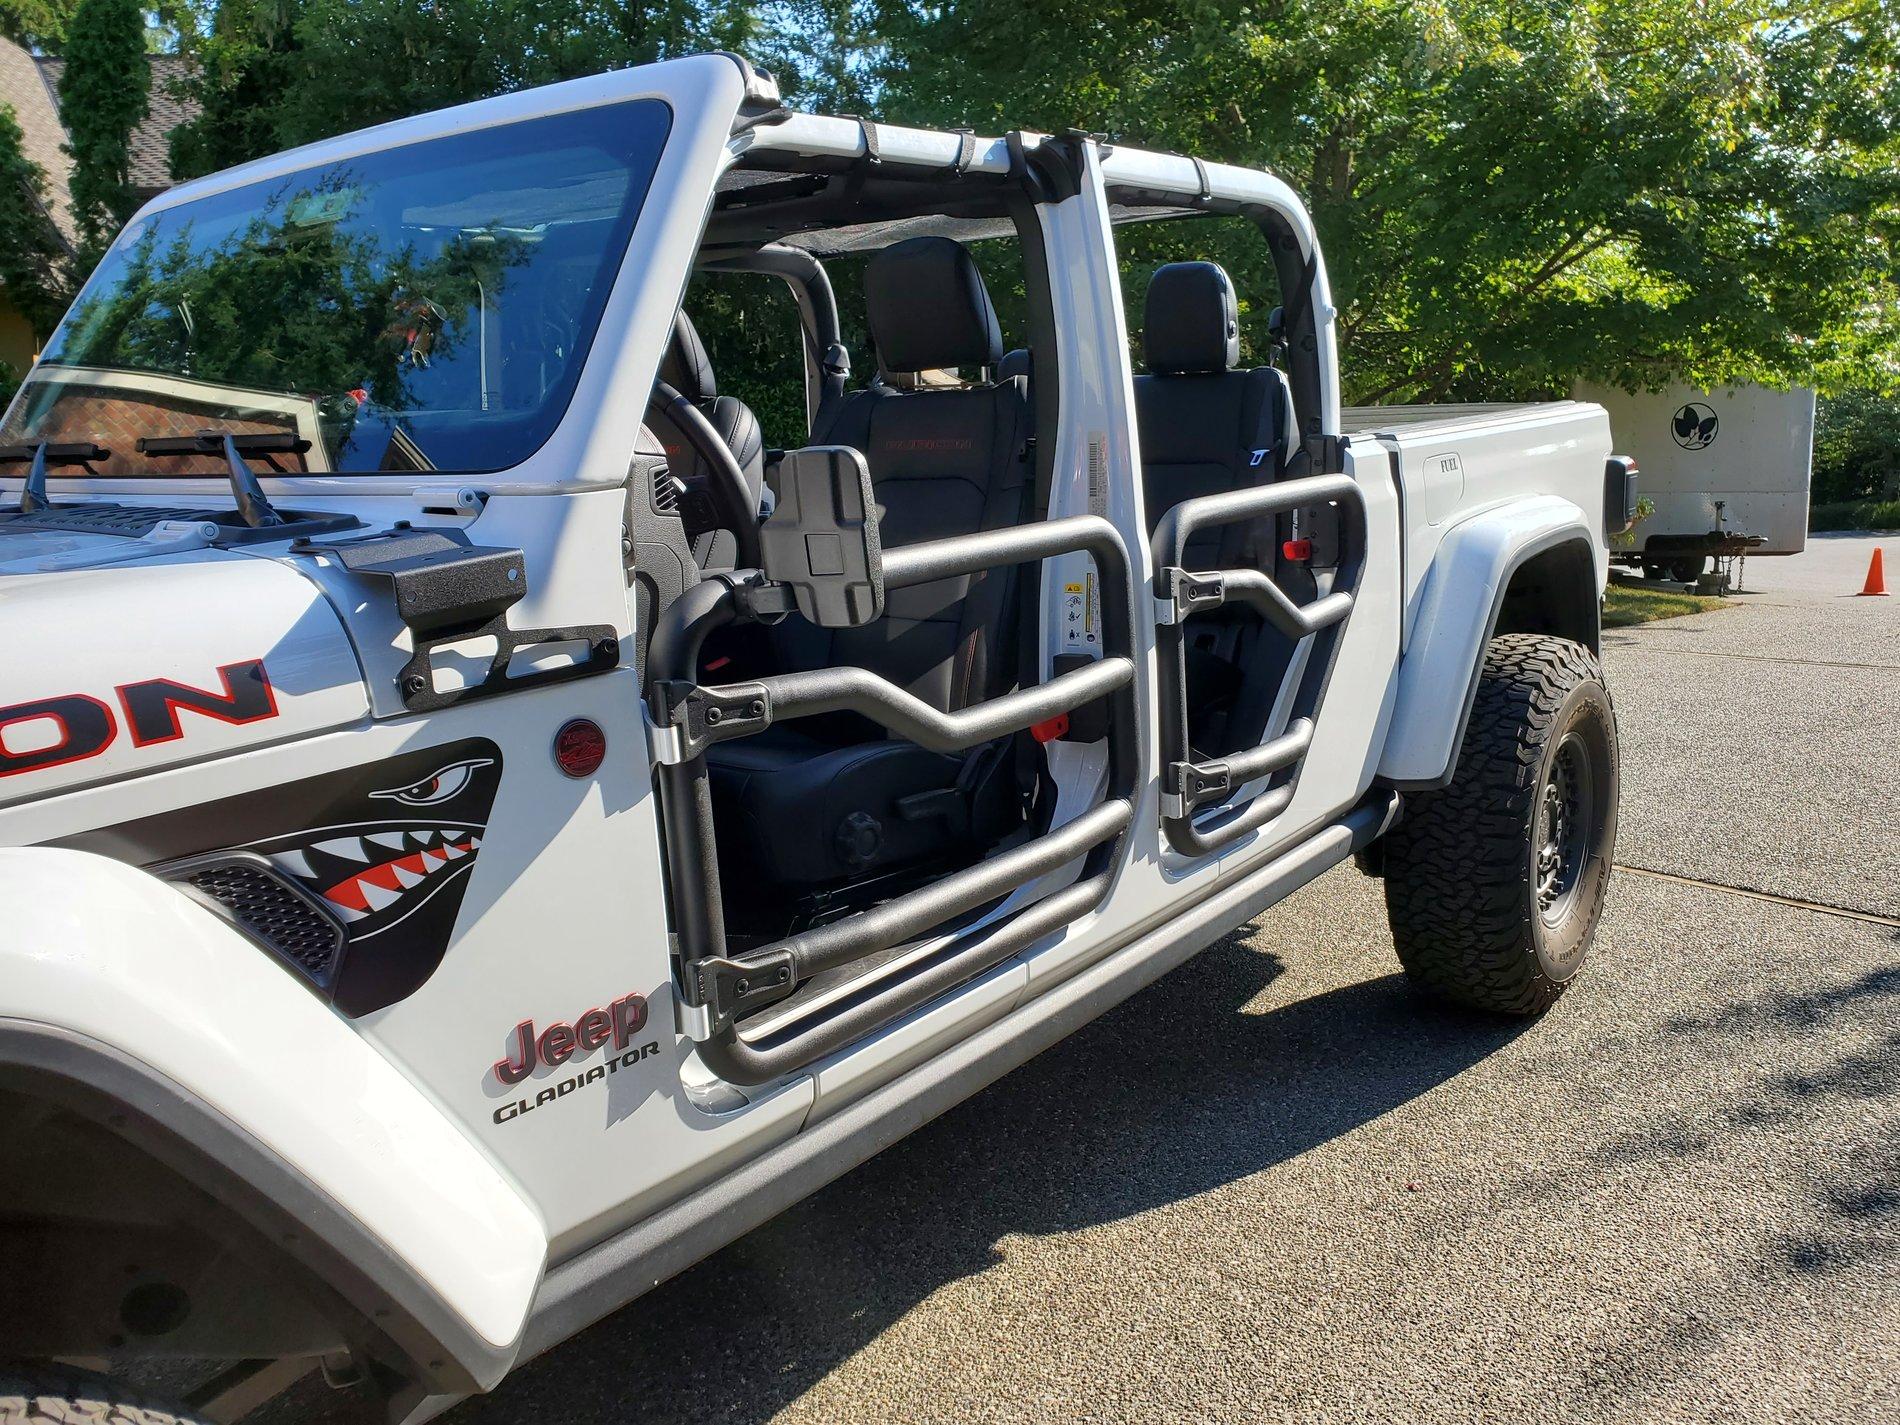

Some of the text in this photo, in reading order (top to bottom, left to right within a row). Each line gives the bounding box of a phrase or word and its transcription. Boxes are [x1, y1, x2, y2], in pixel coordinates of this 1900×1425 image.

[1440, 457, 1458, 473] FUEL
[493, 992, 649, 1086] Jeep
[492, 1041, 660, 1125] GLADIATOR
